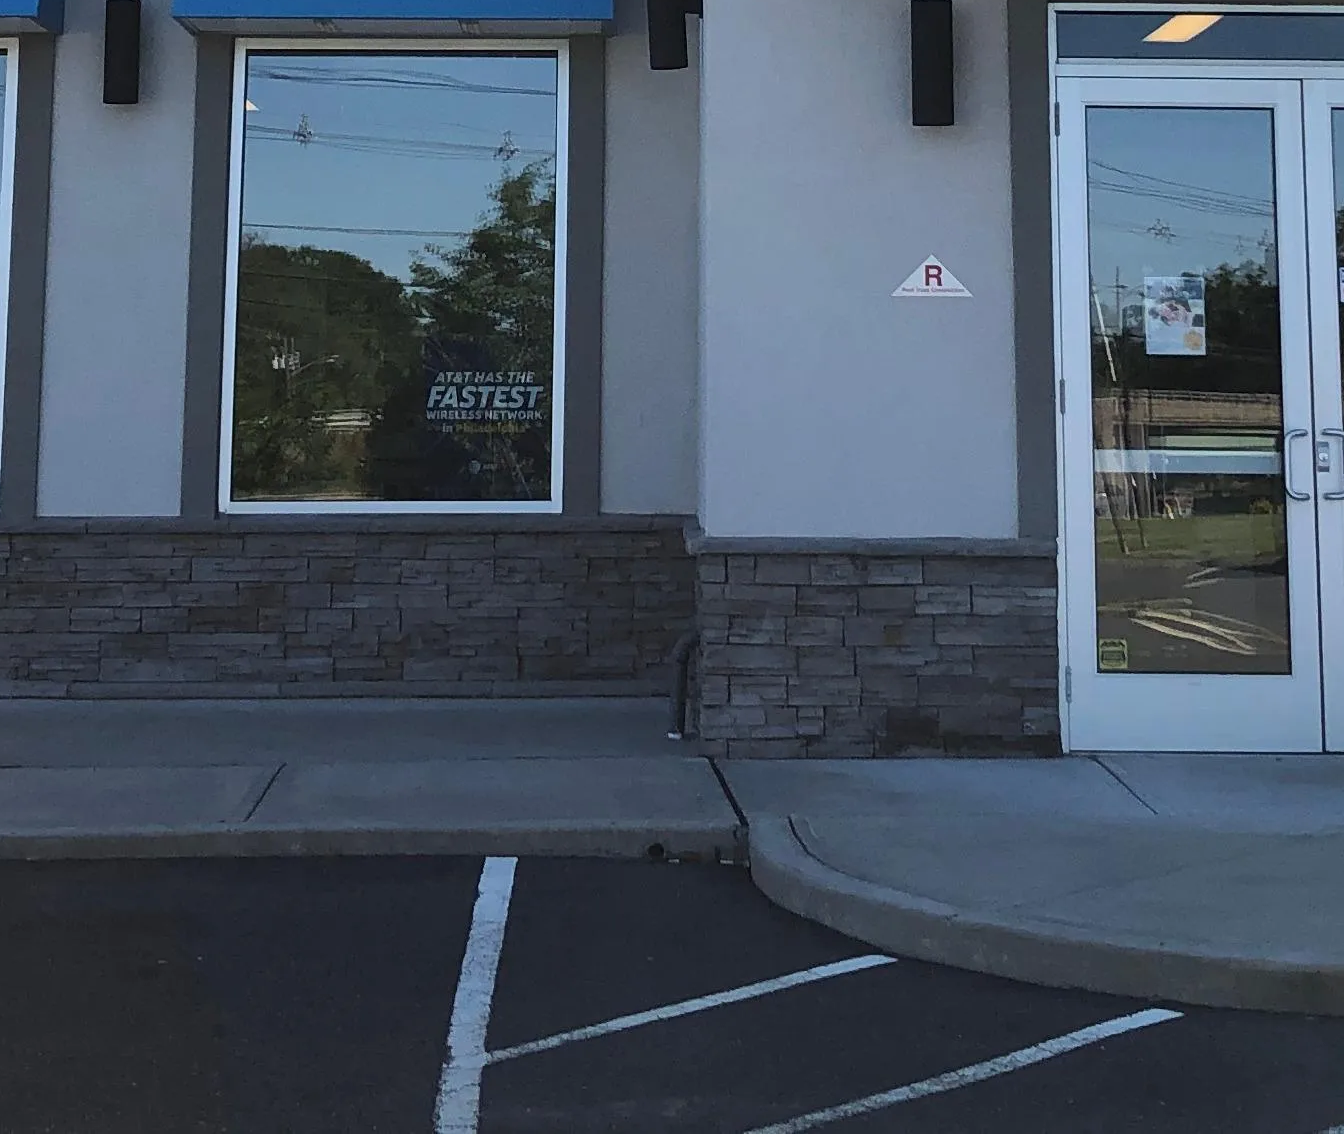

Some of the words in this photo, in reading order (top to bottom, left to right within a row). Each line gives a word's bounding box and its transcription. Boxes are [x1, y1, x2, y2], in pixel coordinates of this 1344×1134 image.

[924, 264, 943, 287] R
[434, 371, 472, 383] AT&T
[474, 371, 503, 383] HAS
[507, 371, 536, 384] THE
[426, 385, 545, 409] FASTEST
[426, 410, 482, 420] WIRELESS
[484, 410, 543, 420] NETWORK
